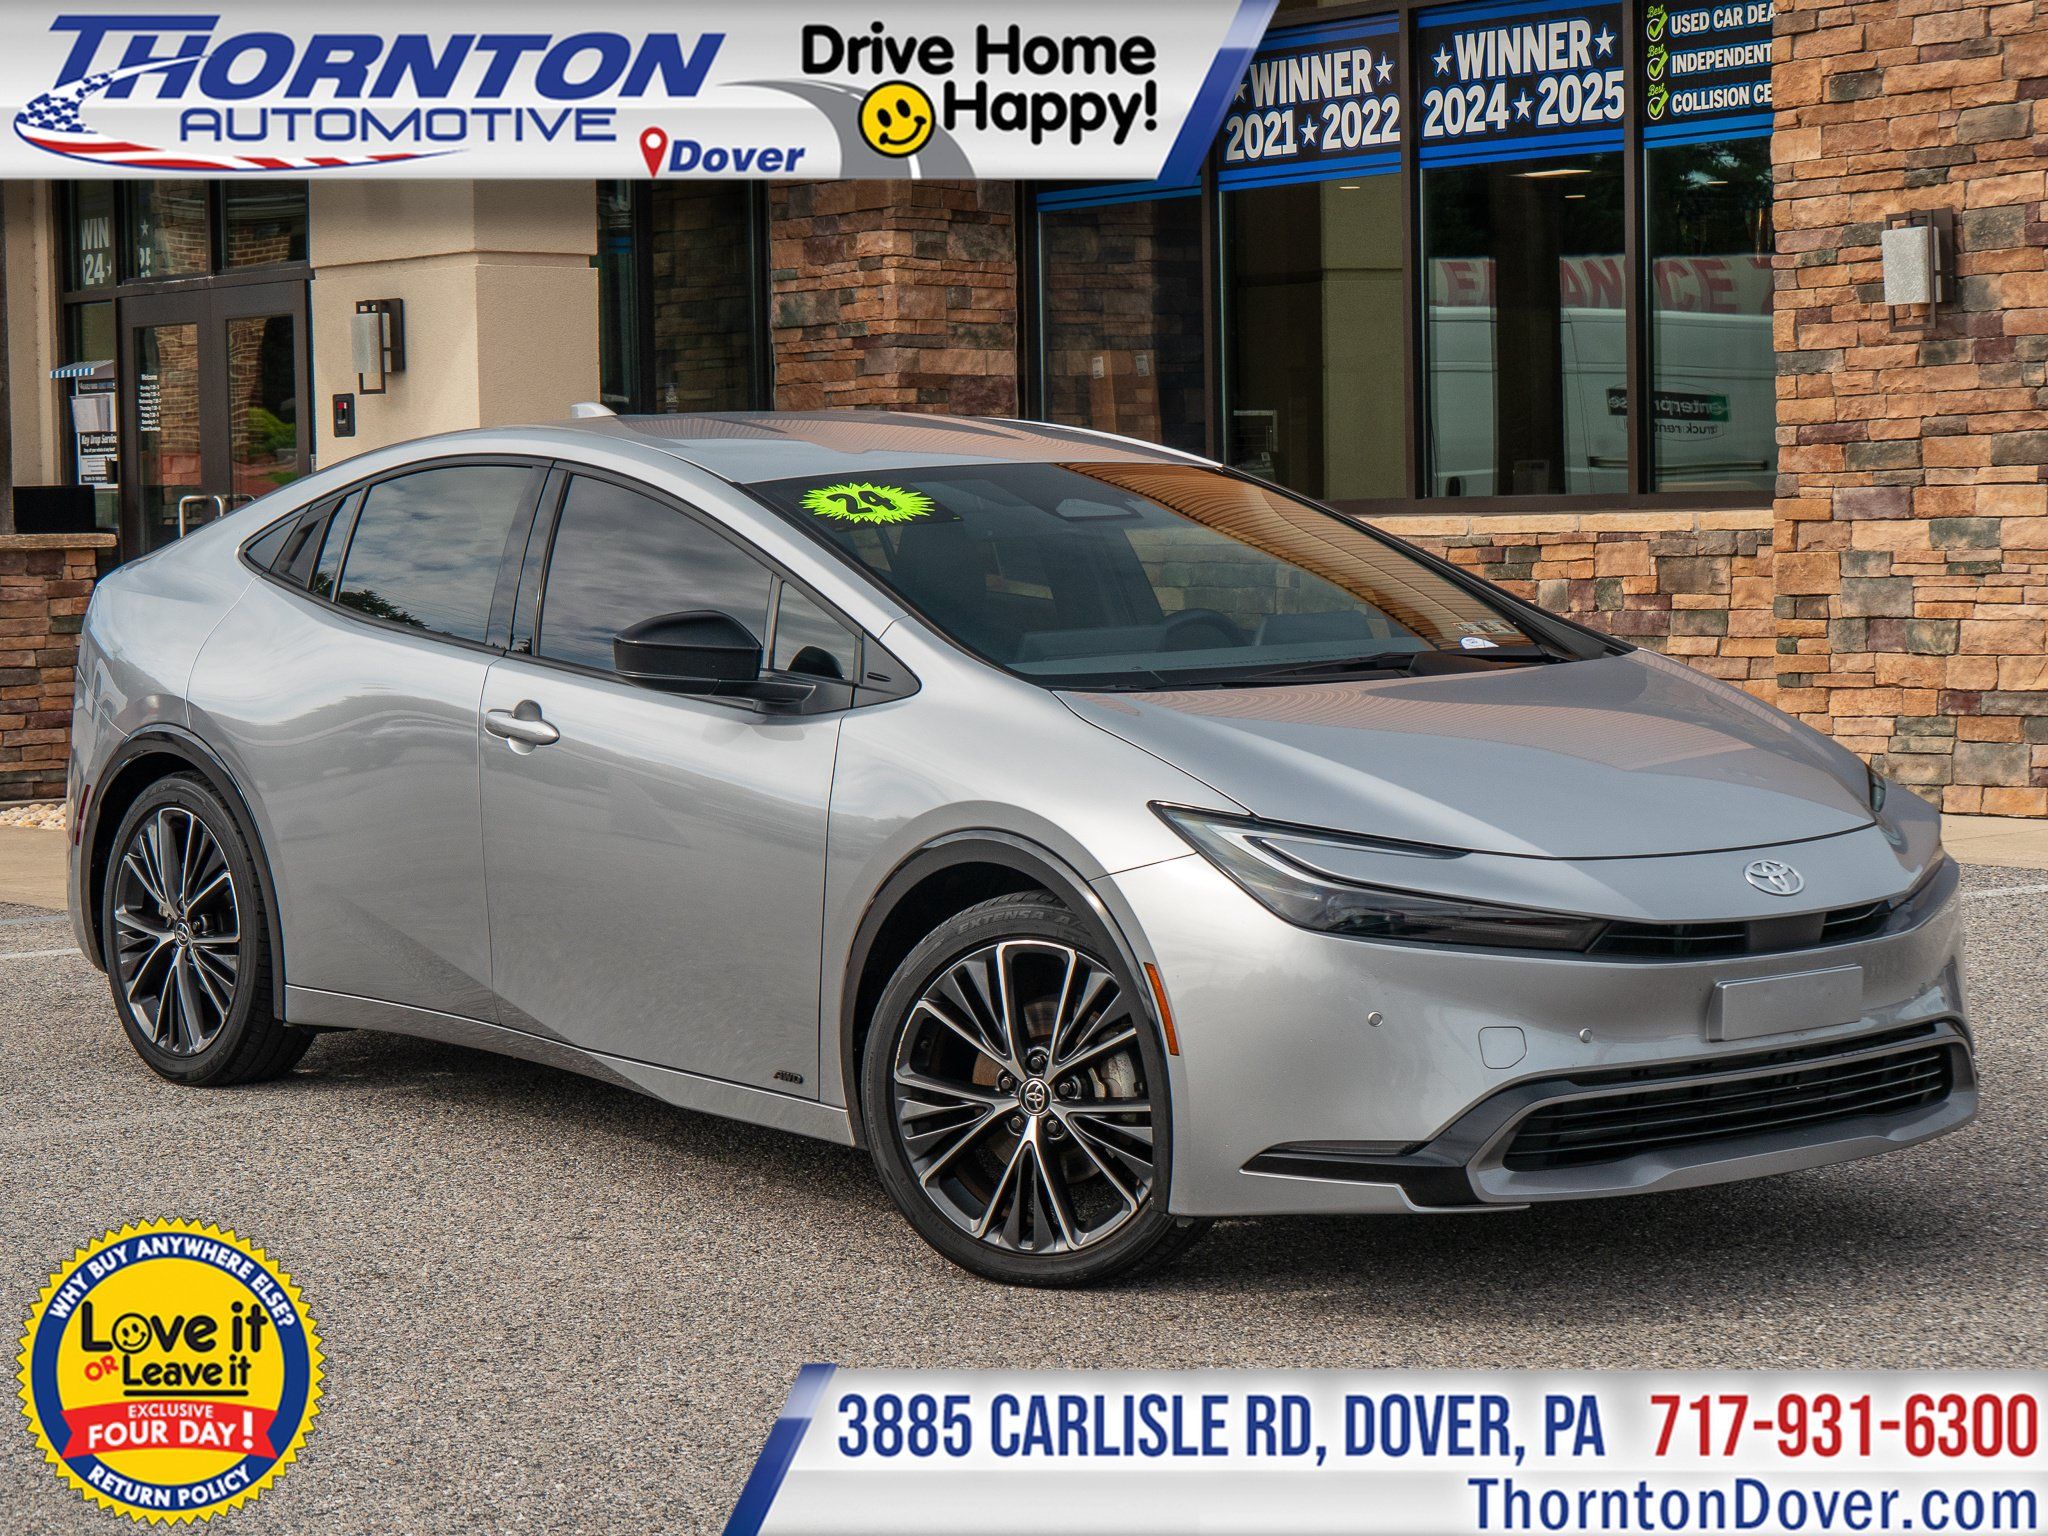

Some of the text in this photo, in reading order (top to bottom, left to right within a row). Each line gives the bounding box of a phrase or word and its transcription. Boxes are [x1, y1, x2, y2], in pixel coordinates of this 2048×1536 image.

[1647, 4, 1664, 18] Best
[1671, 11, 1709, 35] USED
[1713, 7, 1744, 29] CAR
[1454, 19, 1592, 81] WINNER
[1647, 44, 1665, 58] Best
[1671, 43, 1773, 74] INDEPENDENT
[1250, 49, 1373, 108] WINNER
[1648, 83, 1665, 97] Best
[1423, 70, 1625, 137] 2024 2025
[1672, 86, 1750, 114] COLLISION
[1226, 96, 1400, 161] 2021 2022
[827, 490, 897, 514] 24
[957, 909, 1045, 934] EXTENSA
